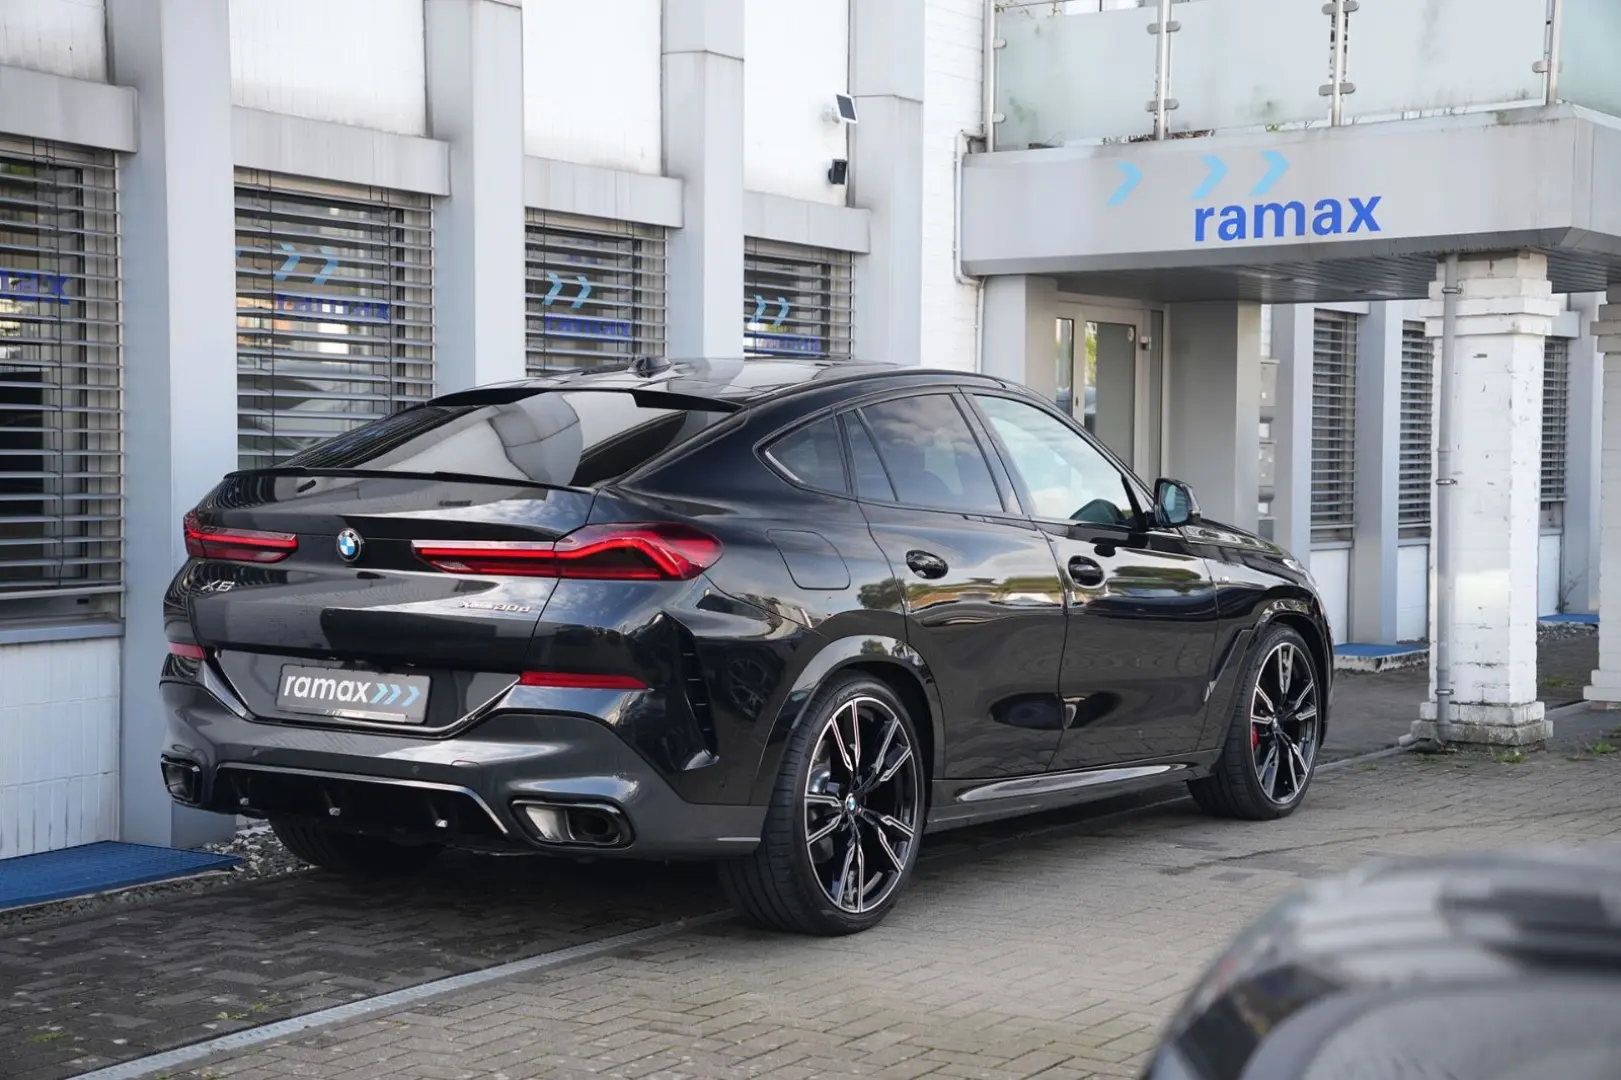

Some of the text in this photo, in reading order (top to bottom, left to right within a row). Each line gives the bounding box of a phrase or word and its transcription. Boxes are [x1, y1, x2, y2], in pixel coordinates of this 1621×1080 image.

[1194, 195, 1382, 242] ramax
[200, 579, 235, 593] X6
[283, 674, 371, 704] ramax
